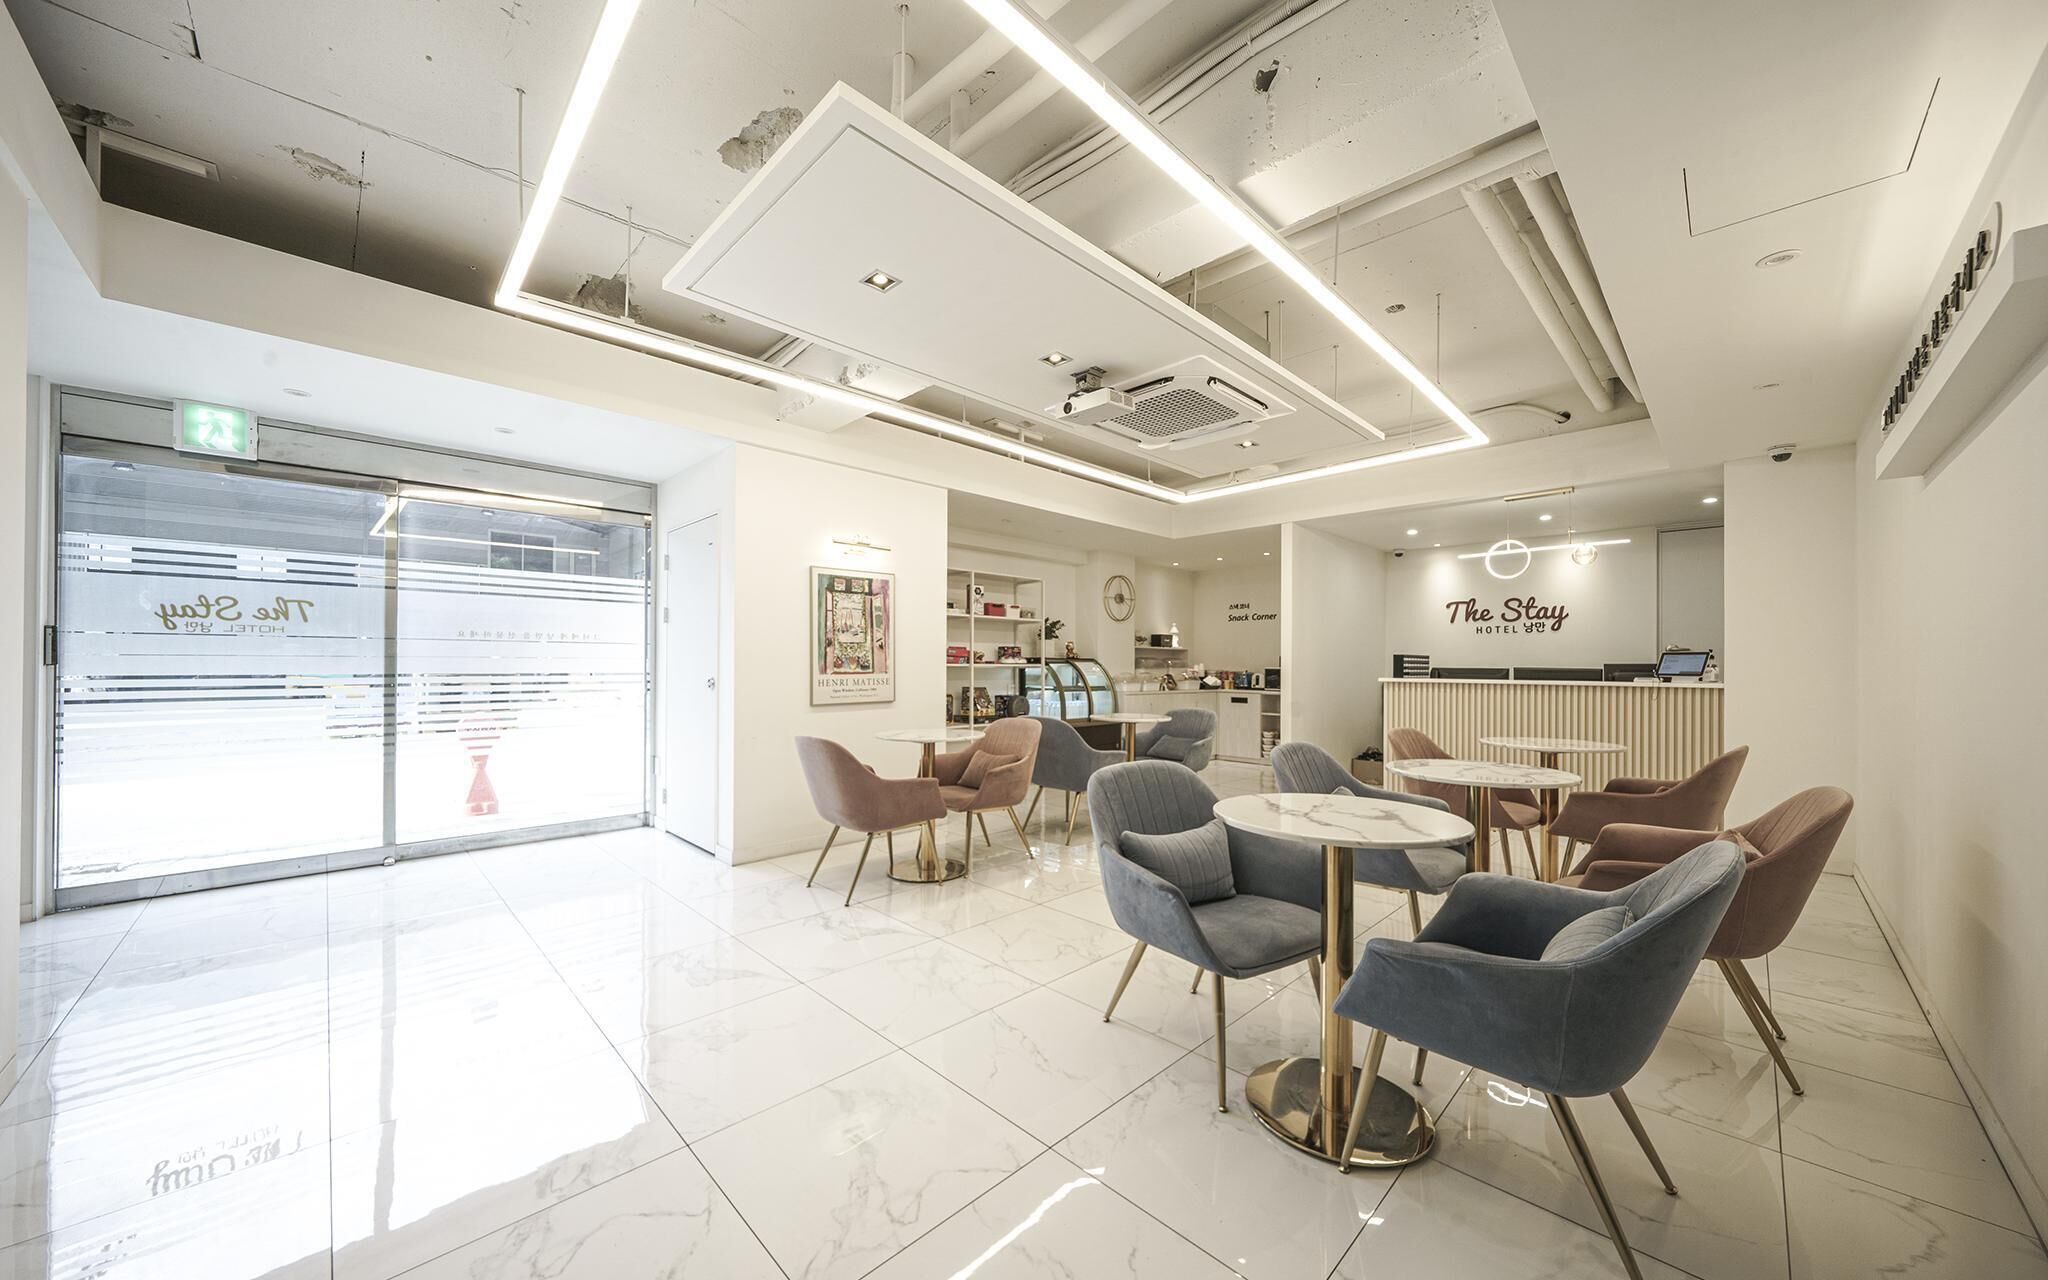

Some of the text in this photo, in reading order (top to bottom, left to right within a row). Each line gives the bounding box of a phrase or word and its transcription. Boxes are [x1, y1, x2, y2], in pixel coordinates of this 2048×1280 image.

[1228, 612, 1277, 622] Snack Corner
[1446, 596, 1569, 631] The Stay
[1476, 621, 1546, 634] HOTEL 낭만
[817, 677, 890, 687] HENRI MATISSE
